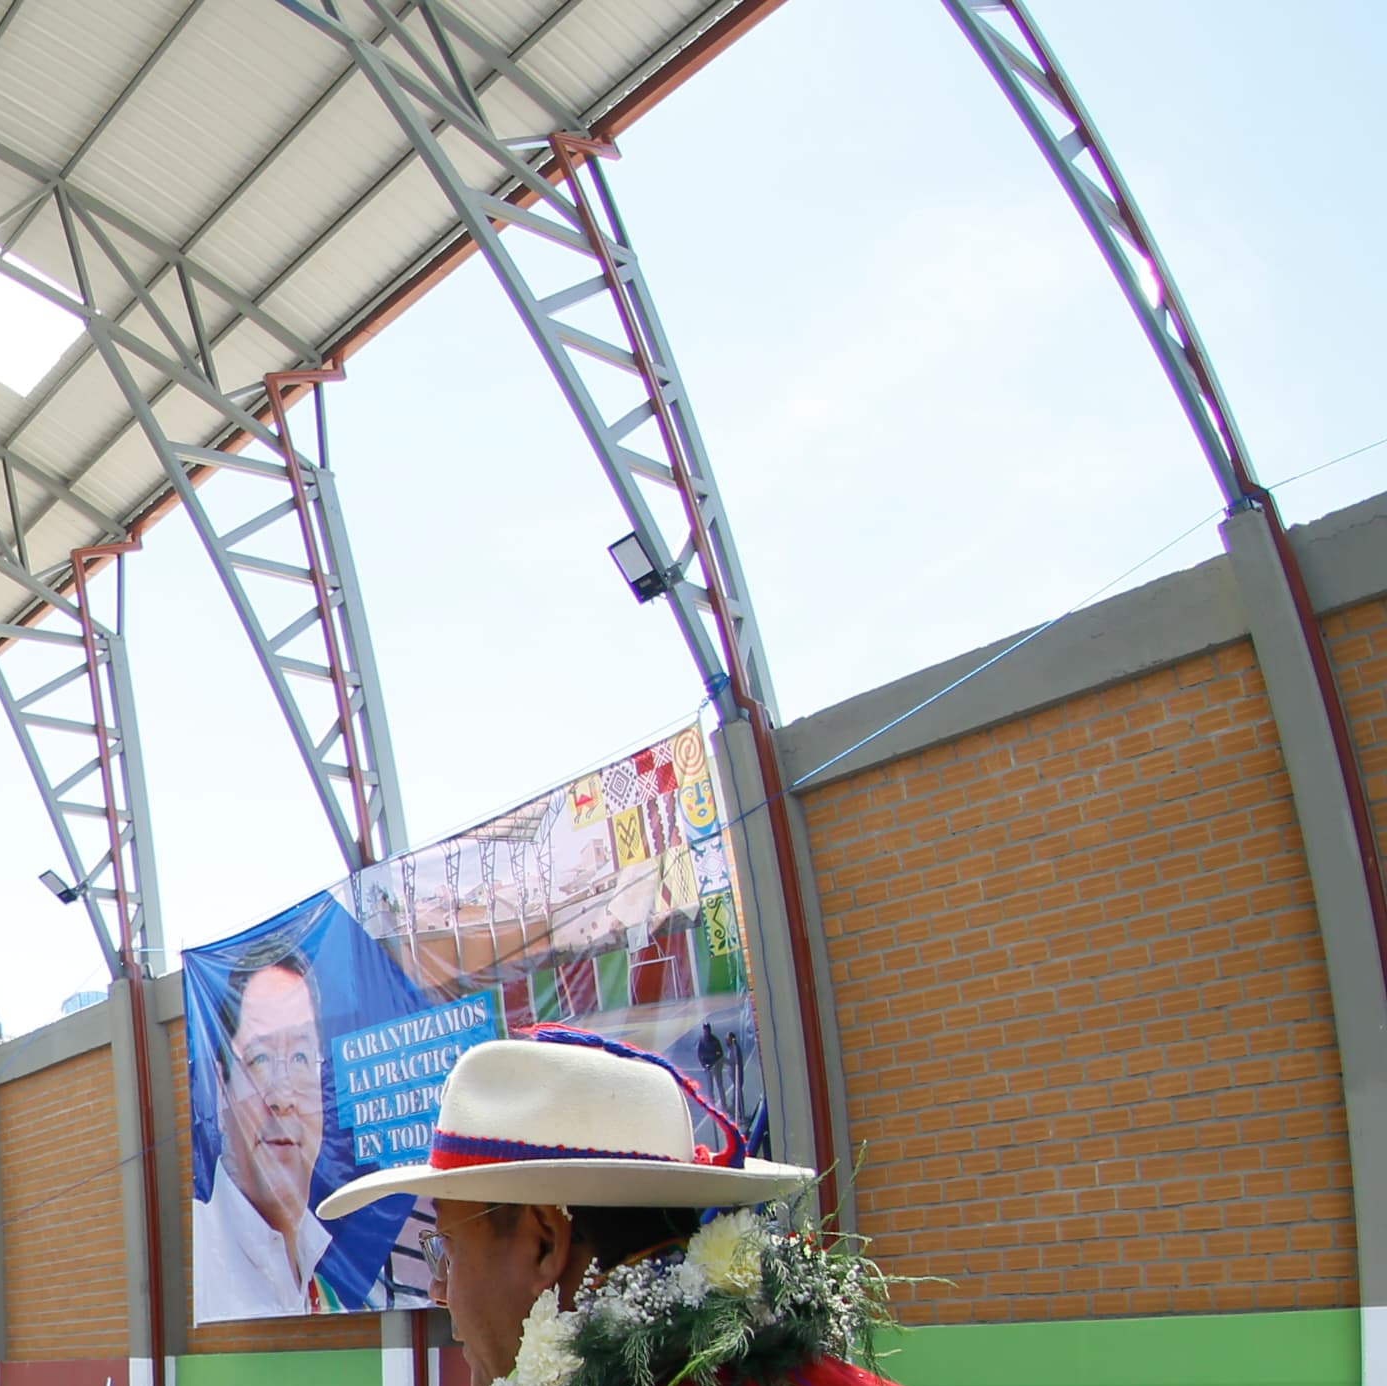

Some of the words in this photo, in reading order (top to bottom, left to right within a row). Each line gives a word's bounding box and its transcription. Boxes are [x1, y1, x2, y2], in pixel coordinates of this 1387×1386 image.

[342, 998, 487, 1062] GARANTIZAMOS
[348, 1068, 372, 1095] LA
[355, 1097, 394, 1126] DEL
[396, 1084, 443, 1116] DEPO
[357, 1132, 383, 1159] EN
